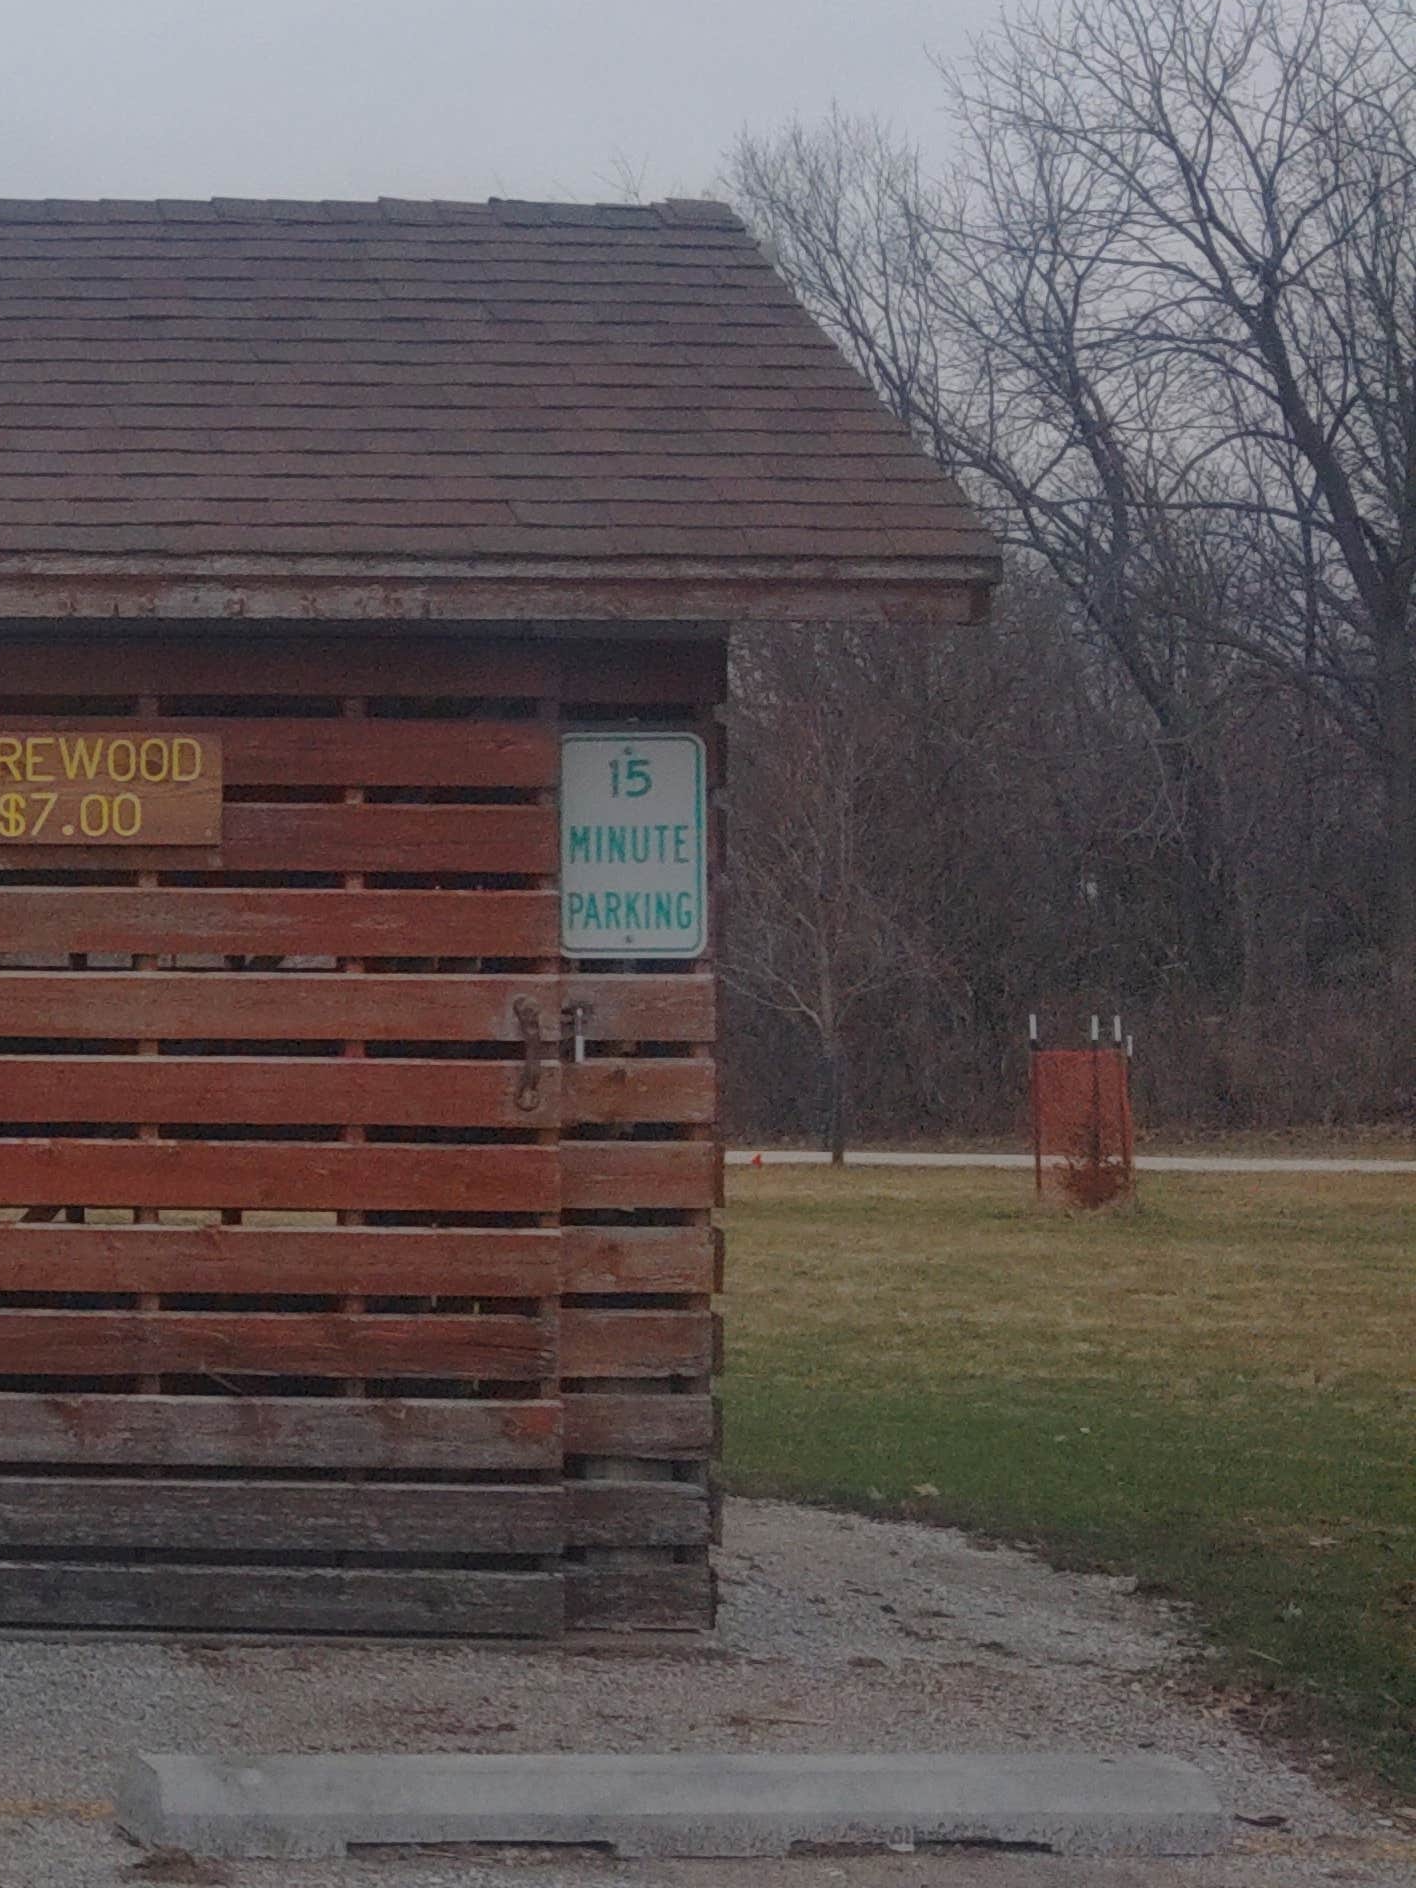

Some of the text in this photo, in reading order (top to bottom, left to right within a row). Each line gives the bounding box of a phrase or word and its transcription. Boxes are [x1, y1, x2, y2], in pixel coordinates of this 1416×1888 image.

[609, 759, 653, 798] 15
[570, 824, 690, 864] MINUTE
[567, 891, 694, 930] PARKING
